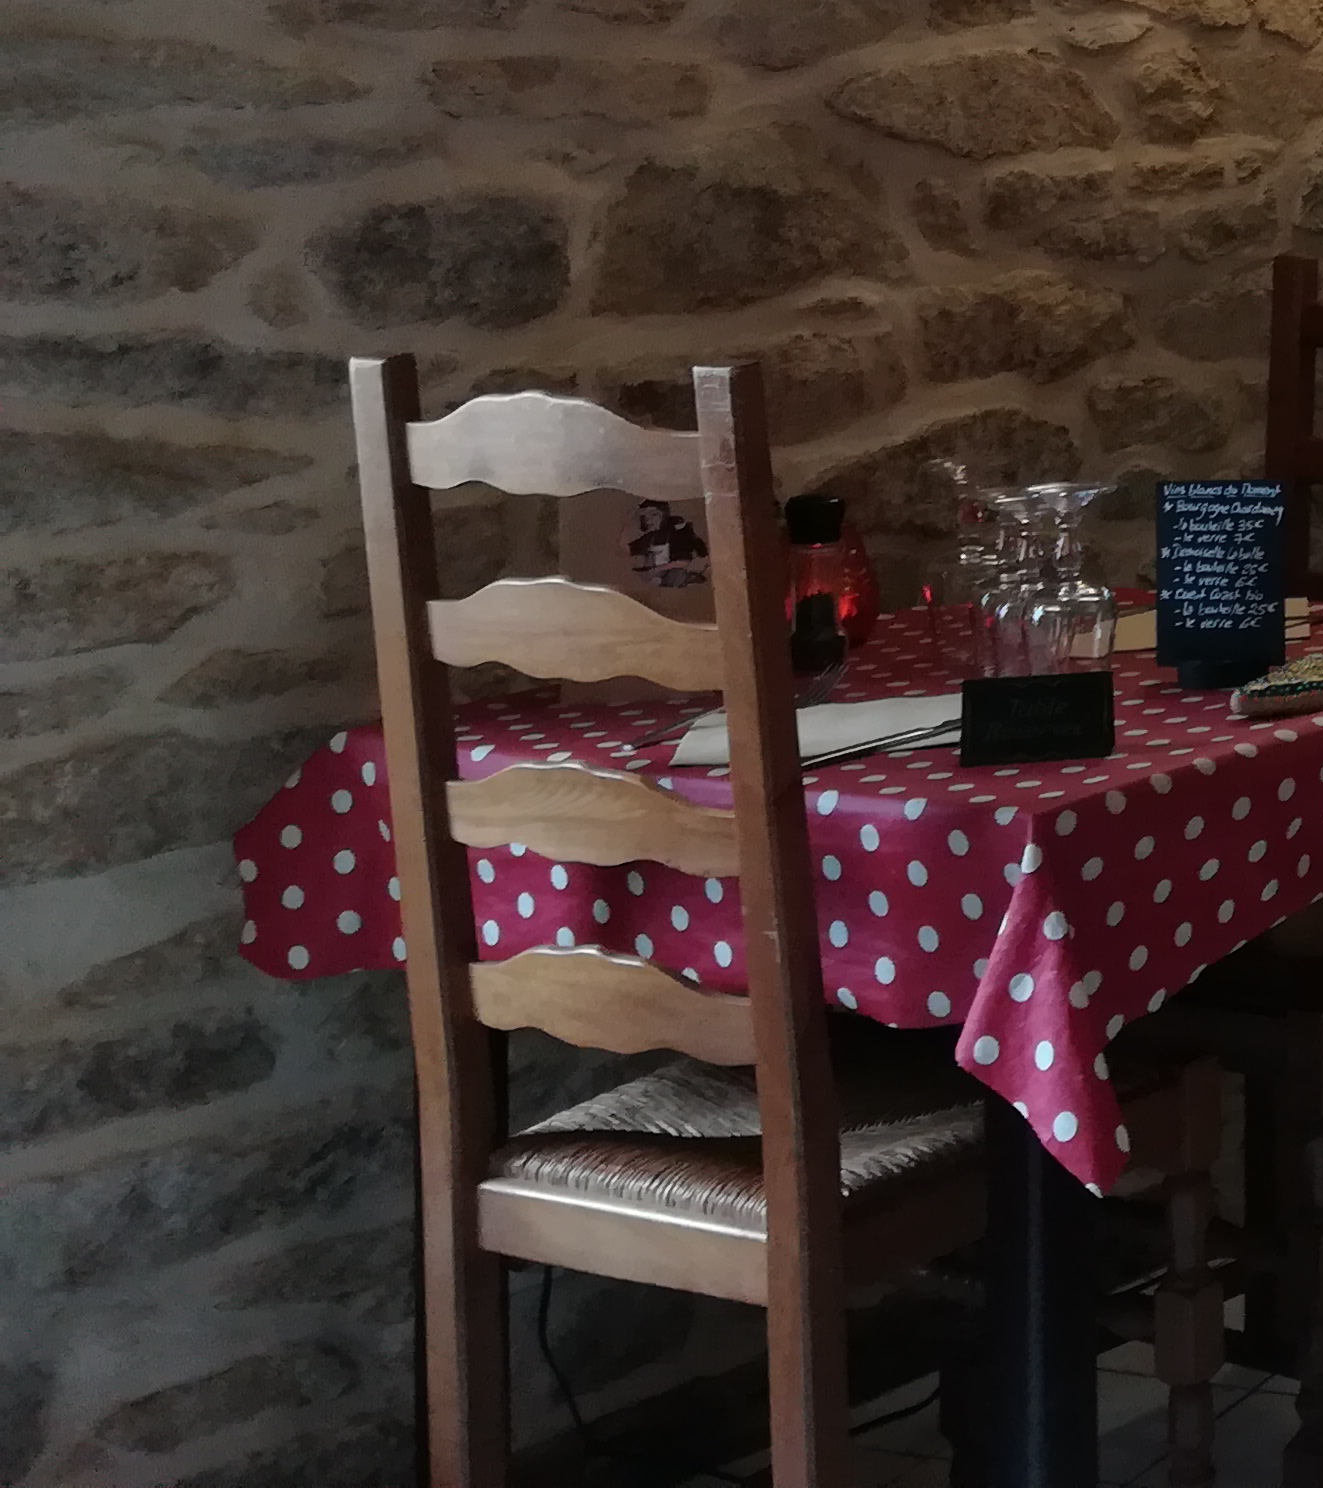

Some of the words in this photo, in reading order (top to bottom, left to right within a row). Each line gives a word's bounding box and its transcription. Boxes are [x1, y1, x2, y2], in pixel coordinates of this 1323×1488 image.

[1164, 483, 1186, 496] Vins
[1189, 484, 1222, 496] blancs
[1175, 500, 1230, 520] Bourgogne
[1189, 518, 1235, 531] bouteille
[1237, 519, 1264, 531] 35€
[1198, 532, 1227, 542] verre
[1233, 532, 1256, 544] 7€
[1198, 576, 1229, 587] verre
[1197, 602, 1247, 616] bouteille
[1249, 602, 1279, 615] 25€
[1200, 618, 1234, 629] verre
